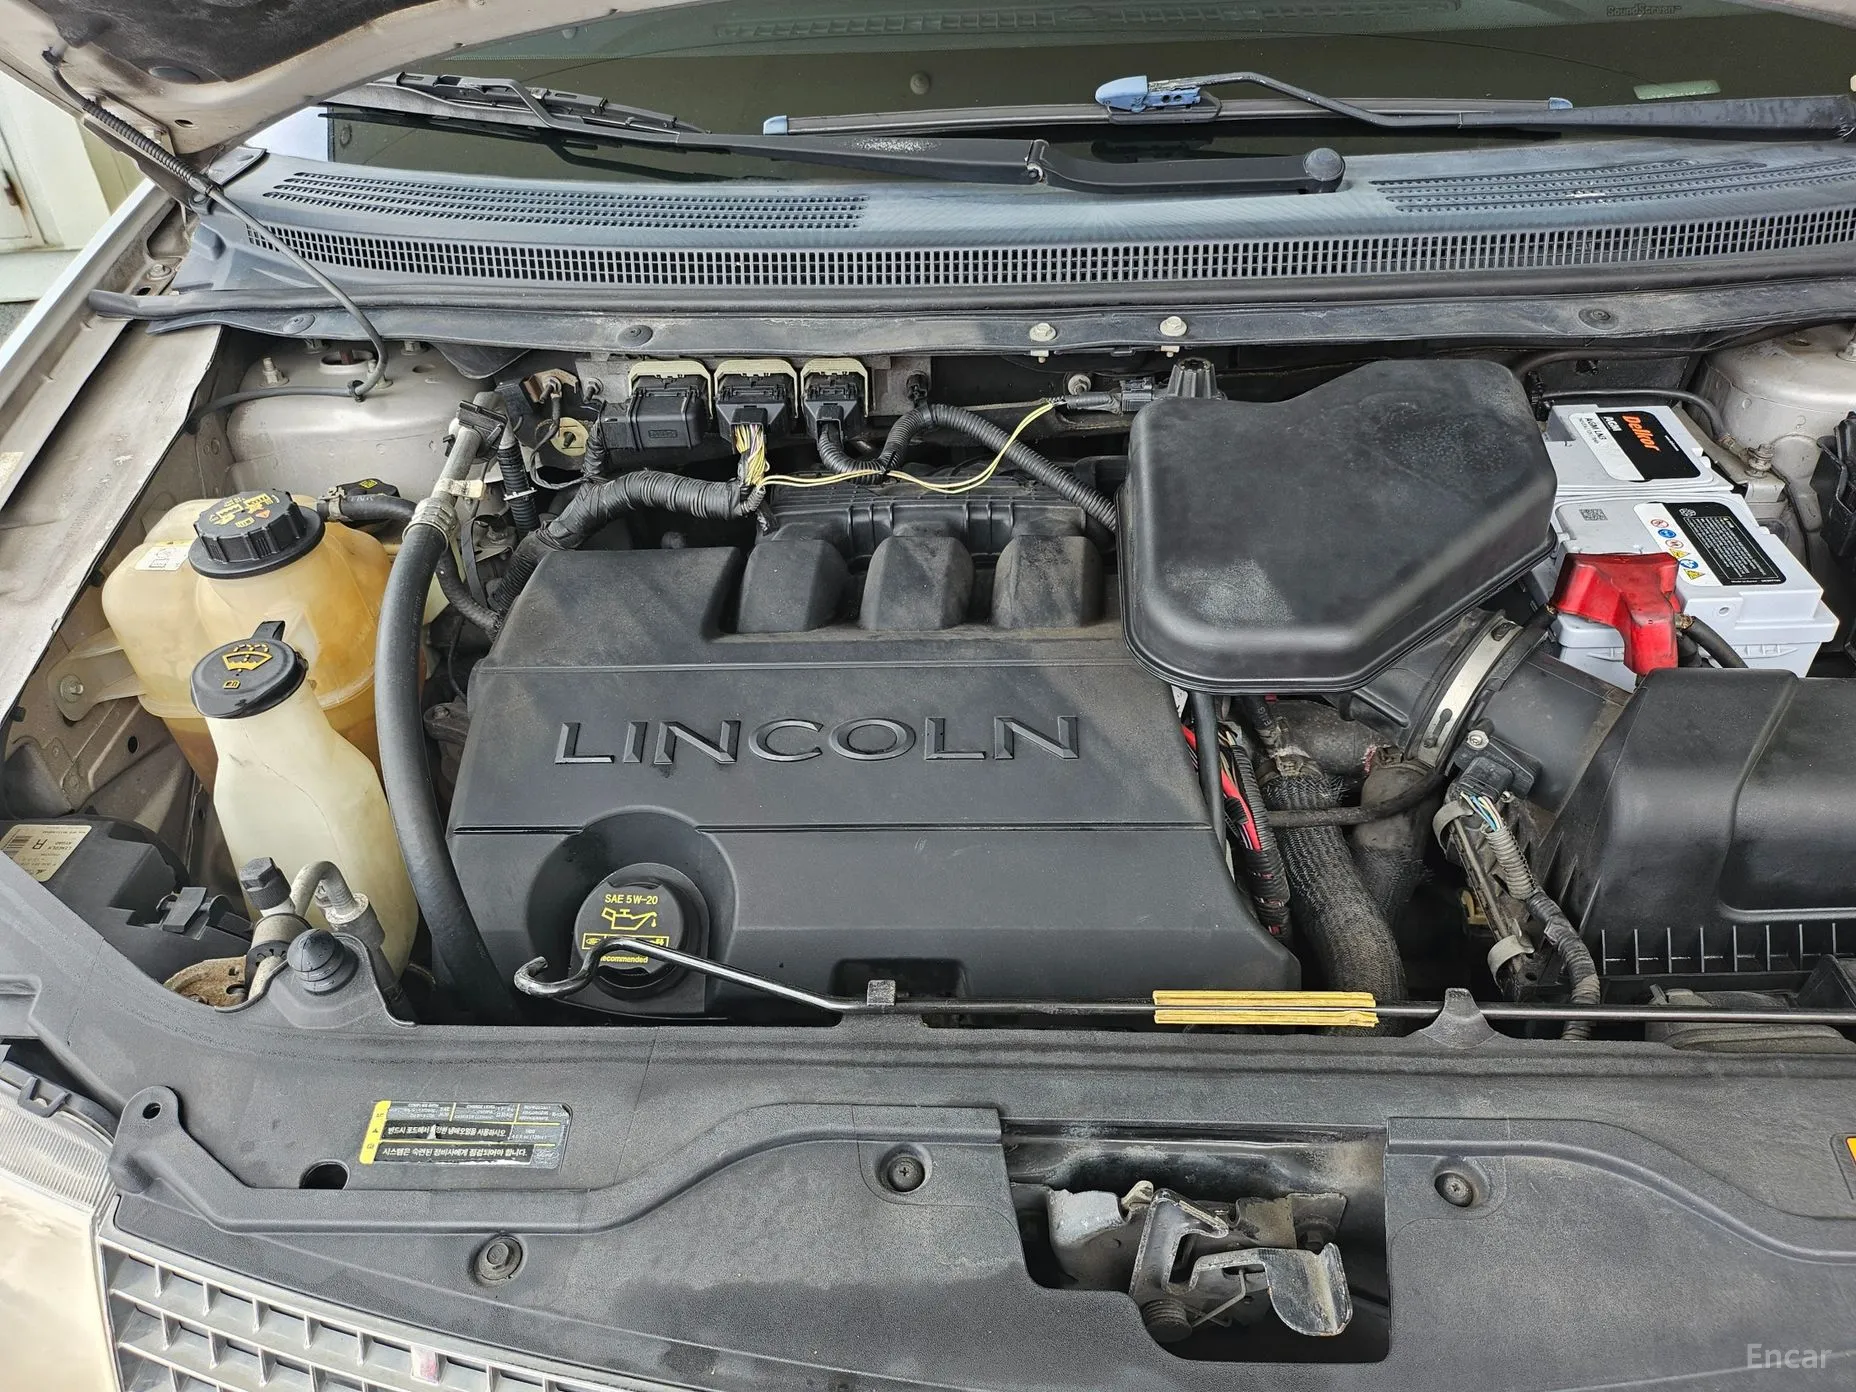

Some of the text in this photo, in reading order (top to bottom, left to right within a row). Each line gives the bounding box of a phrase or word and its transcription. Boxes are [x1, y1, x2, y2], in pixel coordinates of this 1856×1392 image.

[1602, 415, 1622, 432] AGM
[554, 716, 1079, 765] LINCOLN
[32, 838, 48, 849] R
[604, 893, 659, 905] SAE 5W-20
[387, 1126, 406, 1135] 반드시
[406, 1126, 430, 1135] 포드에서
[477, 1128, 507, 1137] 사용하시오
[382, 1147, 411, 1156] 시스템은
